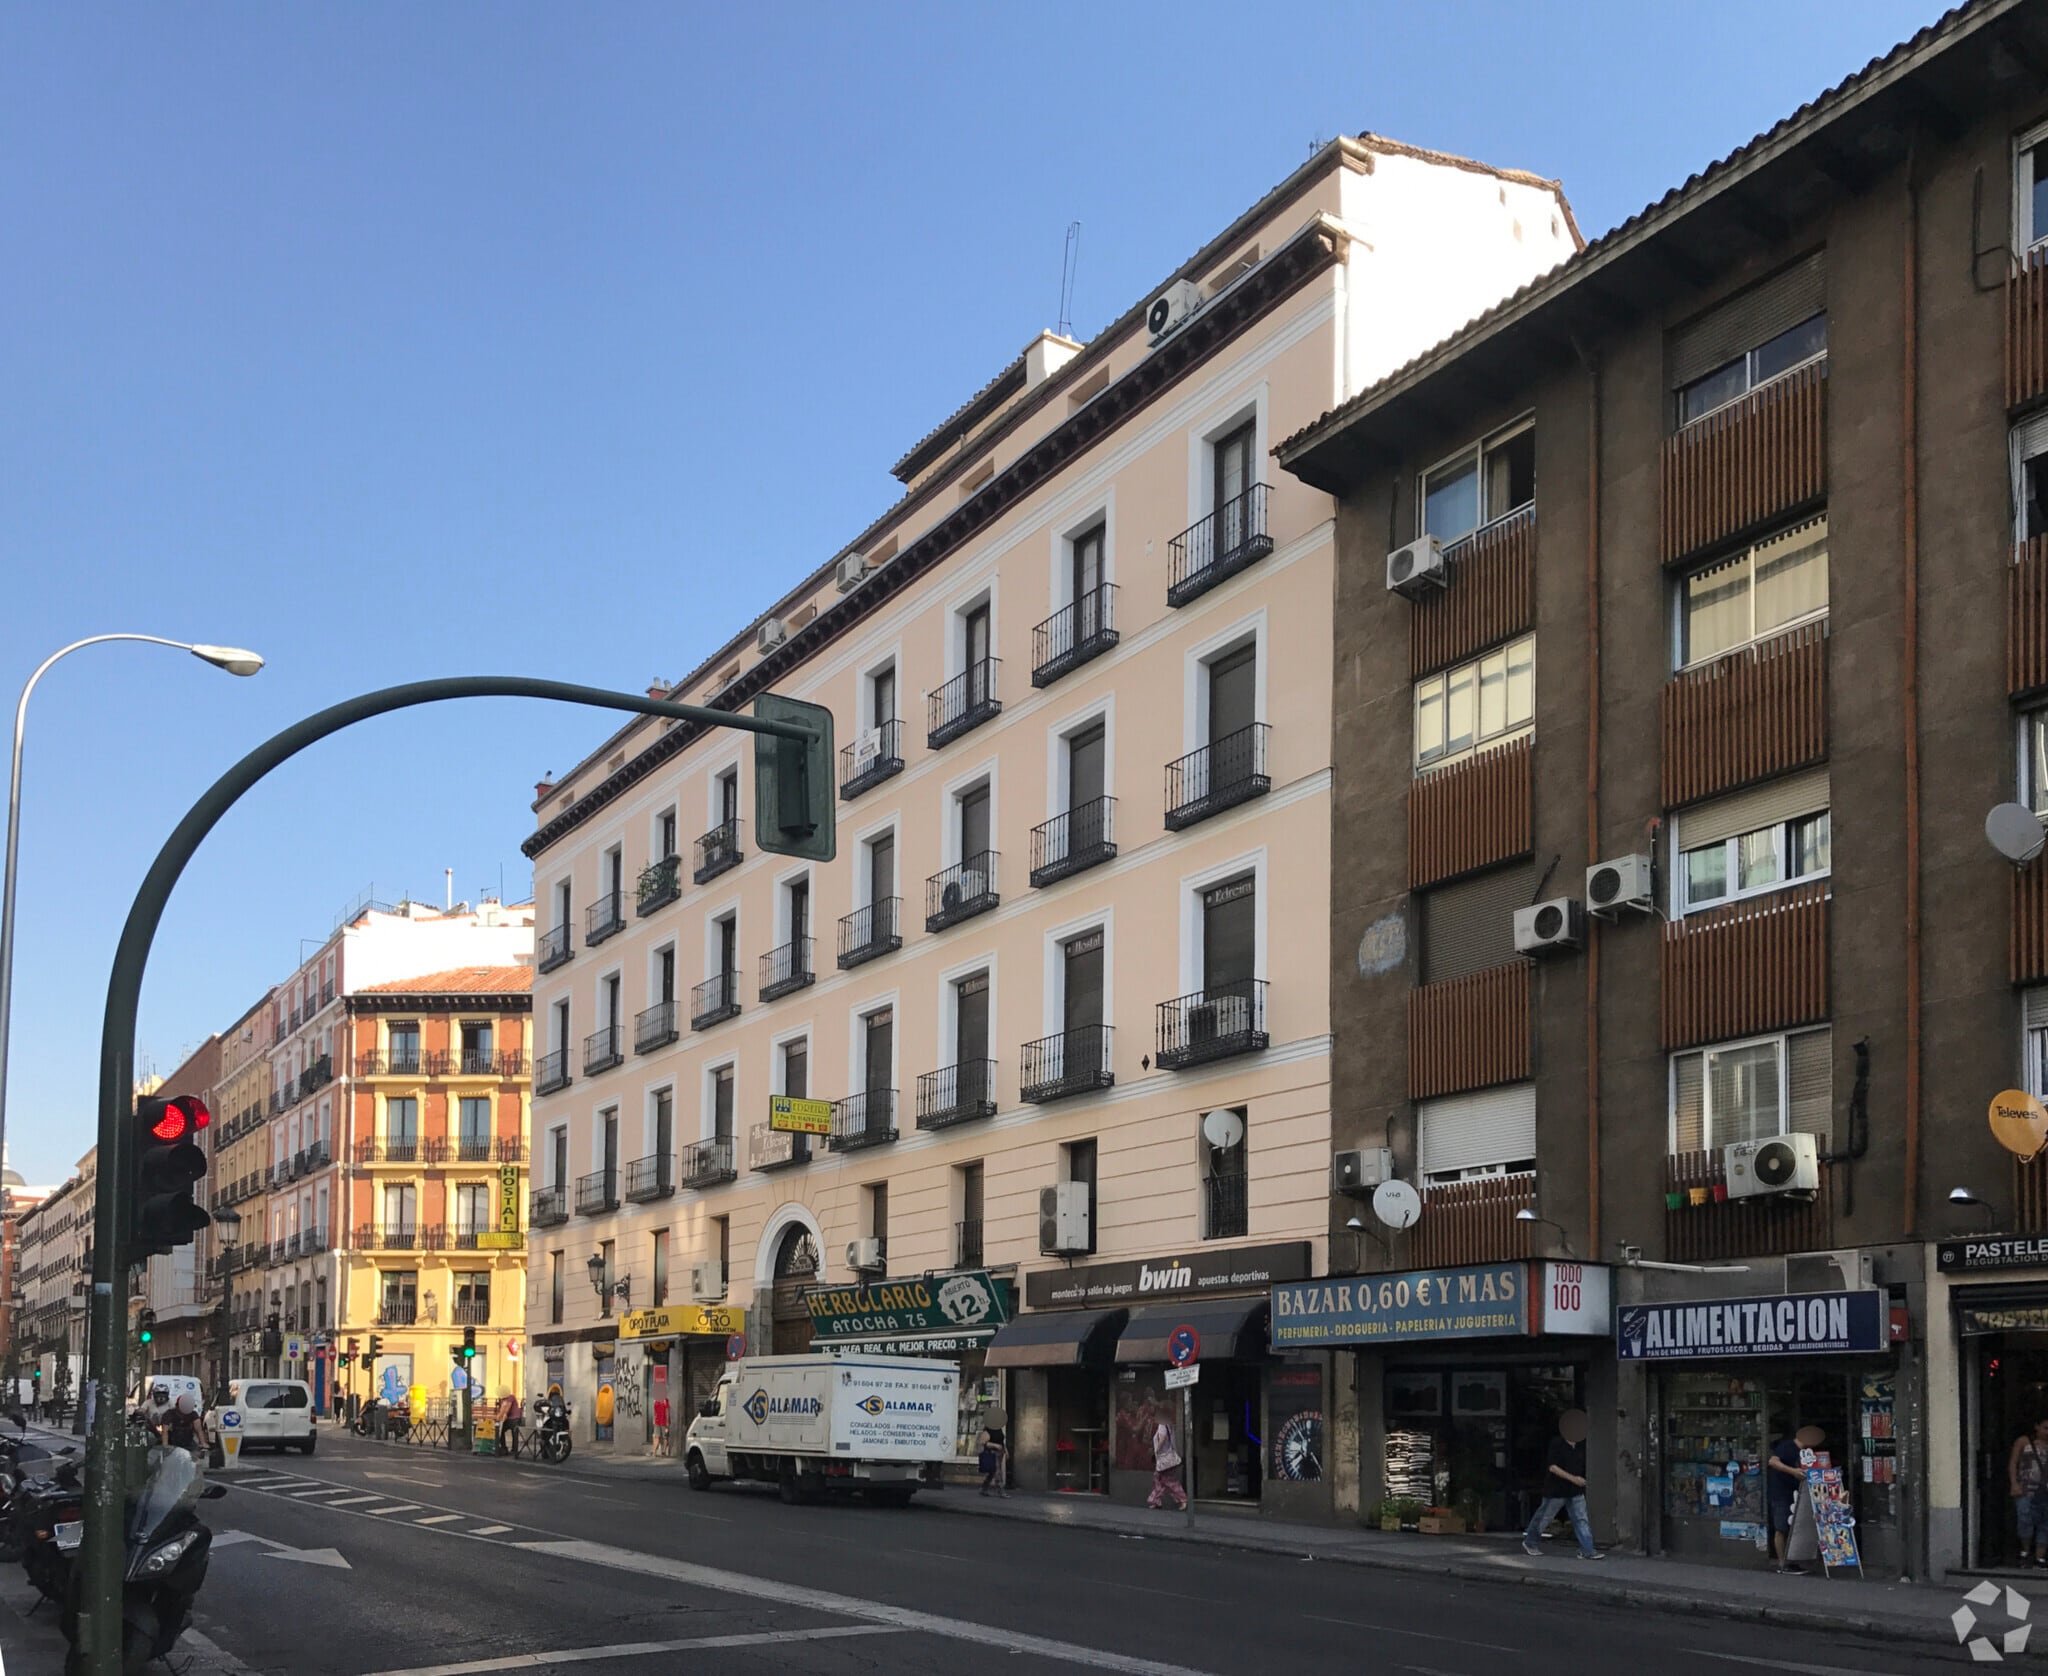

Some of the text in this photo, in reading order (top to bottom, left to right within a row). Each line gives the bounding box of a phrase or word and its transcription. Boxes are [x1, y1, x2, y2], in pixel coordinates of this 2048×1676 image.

[502, 1167, 515, 1225] HOSTAL
[1965, 1239, 2048, 1258] PASTELE
[1966, 1254, 2039, 1266] DEGUSTACION
[1138, 1259, 1192, 1292] bwin
[1197, 1271, 1270, 1286] apuestas deportivas
[1554, 1263, 1582, 1284] TODO
[943, 1281, 971, 1297] ABIERTO
[1103, 1286, 1111, 1296] de
[1112, 1284, 1133, 1296] juegos
[1278, 1271, 1516, 1317] BAZAR 0,60 € Y MAS
[1553, 1284, 1581, 1311] 100
[804, 1283, 932, 1317] HERBOLARIO
[948, 1294, 982, 1322] 12
[697, 1314, 731, 1327] ORO
[832, 1313, 927, 1333] ATOCHA 75
[1277, 1325, 1329, 1340] PERFUMERIA
[1335, 1321, 1388, 1337] DROGUERIA
[1395, 1317, 1446, 1333] PAPELERIA
[1454, 1313, 1516, 1329] JUGUETERIA
[1646, 1298, 1848, 1348] ALIMENTACION
[839, 1343, 861, 1354] JALEA
[863, 1342, 883, 1353] REAL
[886, 1342, 897, 1352] AL
[899, 1340, 925, 1351] MEJOR
[927, 1338, 957, 1350] PRECIO
[967, 1337, 978, 1348] 75
[1646, 1349, 1660, 1357] PAN
[1697, 1346, 1725, 1354] FRUTOS
[1725, 1345, 1748, 1353] SECOS
[1752, 1343, 1784, 1352] BEBIDAS
[850, 1421, 891, 1429] CONGELADOS
[862, 1437, 889, 1445] JAMONES
[922, 1431, 939, 1439] VINOS
